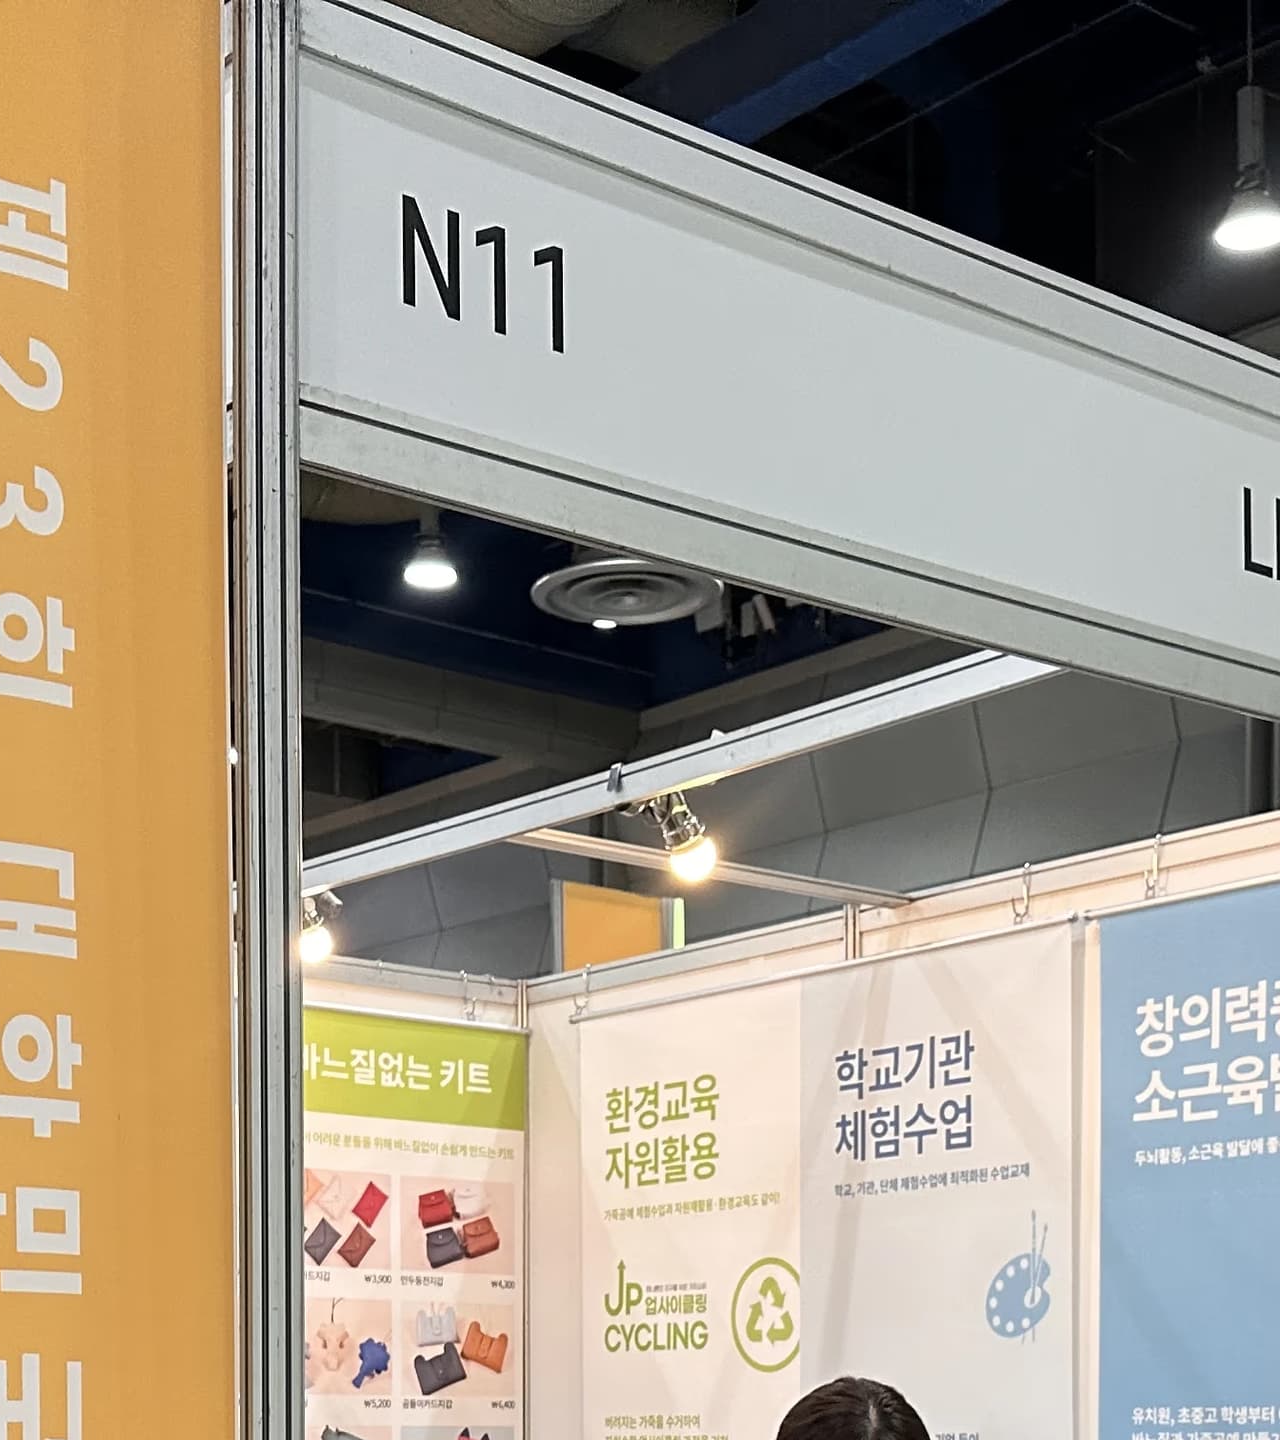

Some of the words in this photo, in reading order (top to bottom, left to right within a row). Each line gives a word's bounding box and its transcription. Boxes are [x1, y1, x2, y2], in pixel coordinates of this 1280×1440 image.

[400, 195, 567, 353] N11
[440, 1059, 492, 1095] 키트
[834, 1030, 975, 1099] 학교기관
[604, 1073, 720, 1135] 환경교육
[834, 1095, 973, 1162] 체험수업
[605, 1132, 719, 1190] 자원활용
[1188, 1143, 1223, 1160] 소근육
[1227, 1138, 1263, 1158] 발달에
[879, 1178, 898, 1193] 단체
[900, 1172, 948, 1190] 체험수업에
[949, 1167, 988, 1184] 최적화된
[990, 1162, 1030, 1179] 수업교재
[645, 1294, 707, 1315] 업사이클링
[604, 1320, 709, 1352] CYCLING
[1132, 1407, 1175, 1426] 유치원,
[1178, 1408, 1217, 1424] 초중고
[1220, 1407, 1274, 1424] 학생부터
